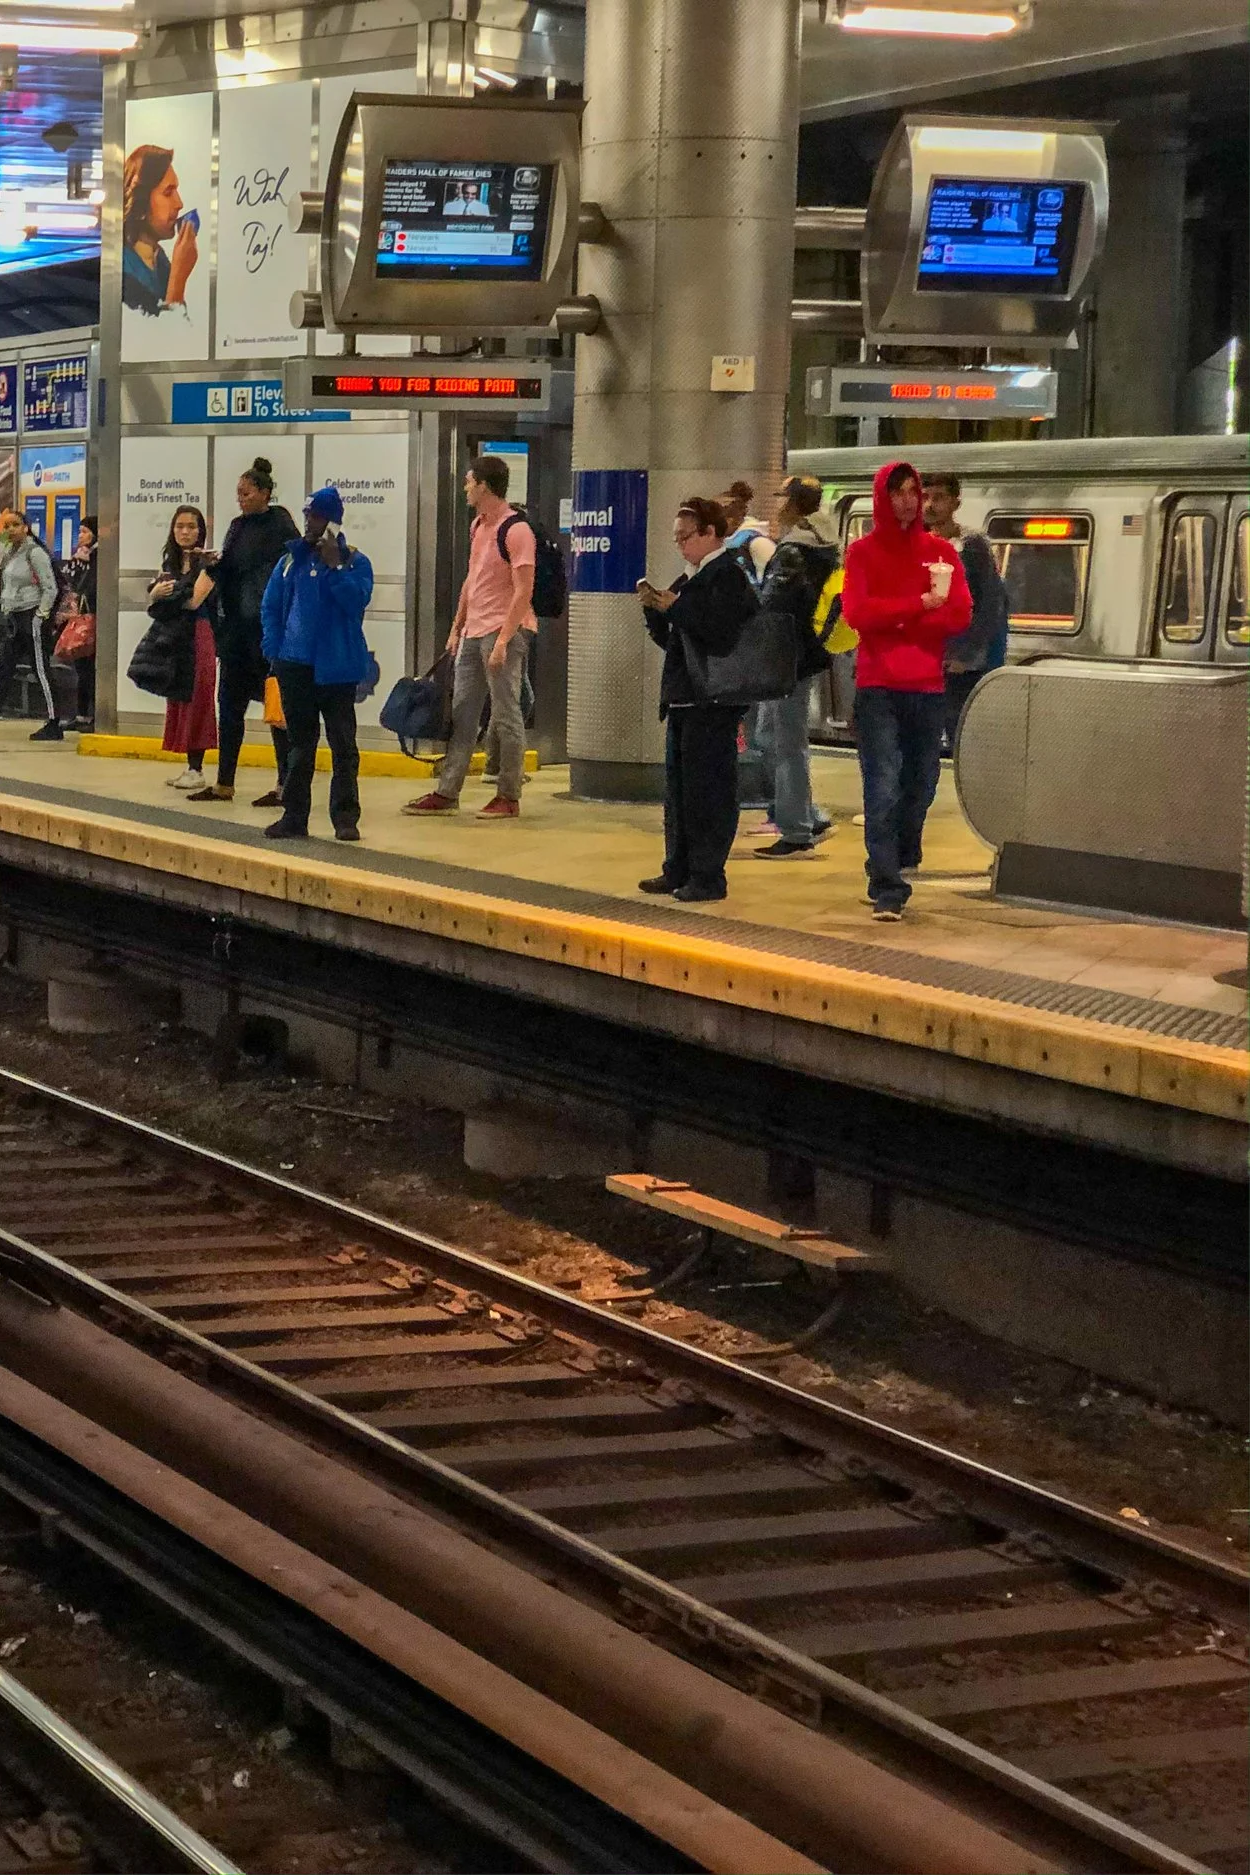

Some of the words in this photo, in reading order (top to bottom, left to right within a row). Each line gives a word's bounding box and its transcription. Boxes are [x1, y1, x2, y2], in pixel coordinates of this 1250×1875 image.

[385, 168, 416, 176] RAIDERS
[418, 169, 437, 177] HALL
[439, 169, 448, 177] OF
[450, 170, 474, 178] FAMER
[475, 170, 492, 178] DIES
[234, 167, 289, 207] Wah
[243, 221, 283, 273] Taj!
[379, 378, 402, 391] YOU
[406, 378, 431, 391] FOR
[435, 379, 480, 392] RIDING
[484, 379, 515, 393] PATH
[936, 385, 952, 399] TO
[254, 403, 269, 416] To
[140, 480, 162, 489] Bond
[164, 479, 185, 489] with
[325, 478, 370, 489] Celebrate
[373, 478, 395, 489] with
[127, 493, 154, 503] India's
[157, 493, 183, 503] Finest
[185, 493, 200, 503] Tea
[342, 493, 385, 504] xcellence
[573, 506, 613, 526] ournal
